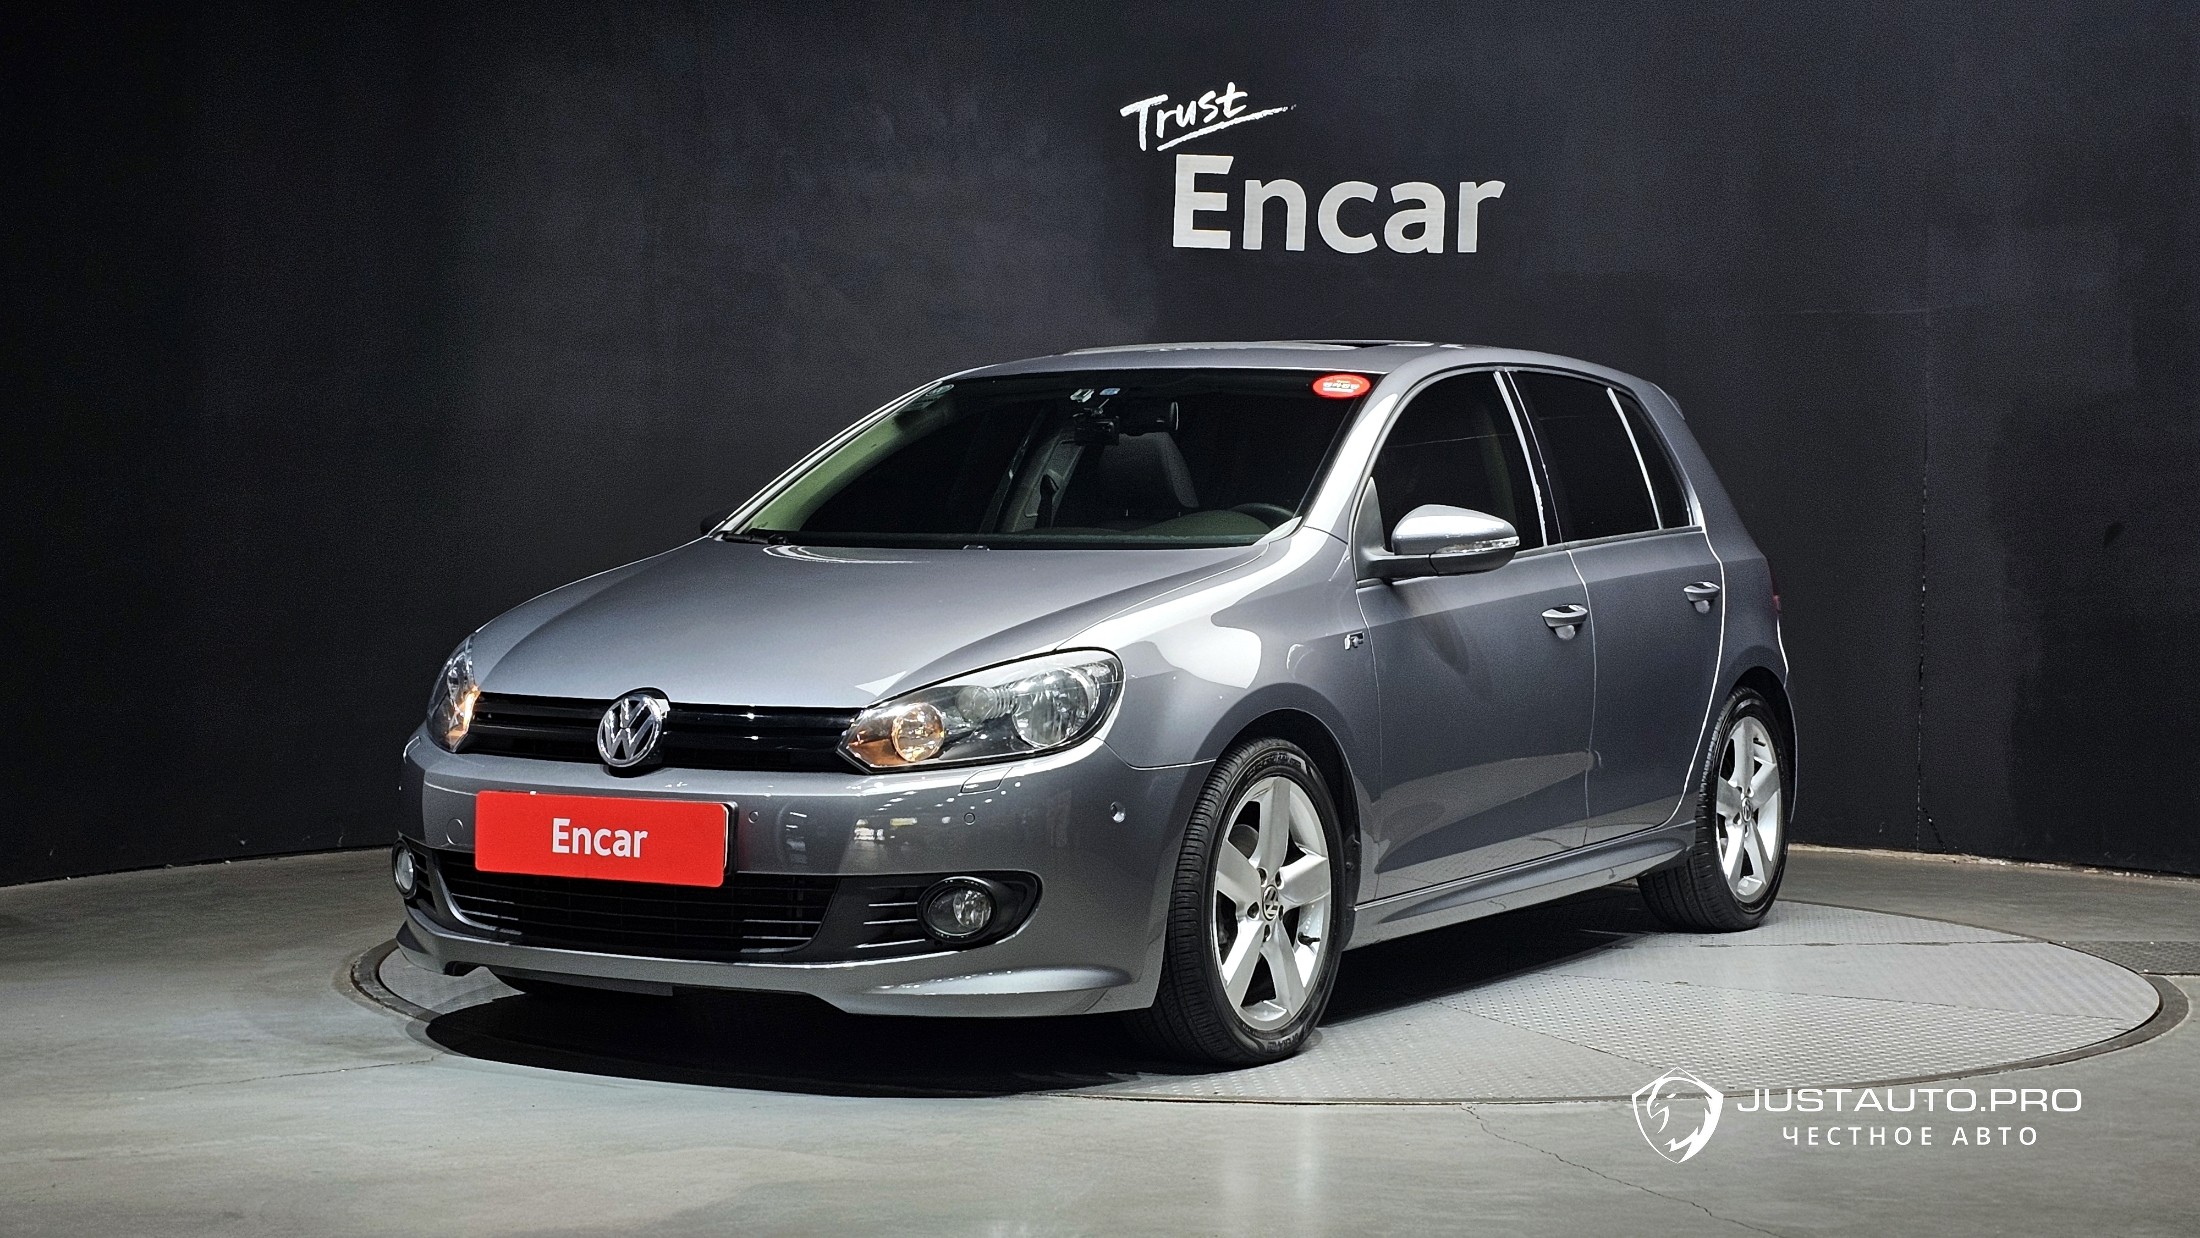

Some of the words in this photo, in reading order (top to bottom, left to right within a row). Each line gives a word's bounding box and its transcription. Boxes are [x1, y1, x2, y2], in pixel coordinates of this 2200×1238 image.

[1120, 81, 1249, 151] Trust
[1173, 154, 1505, 253] Encar
[598, 694, 662, 766] VW
[552, 818, 648, 858] Encar
